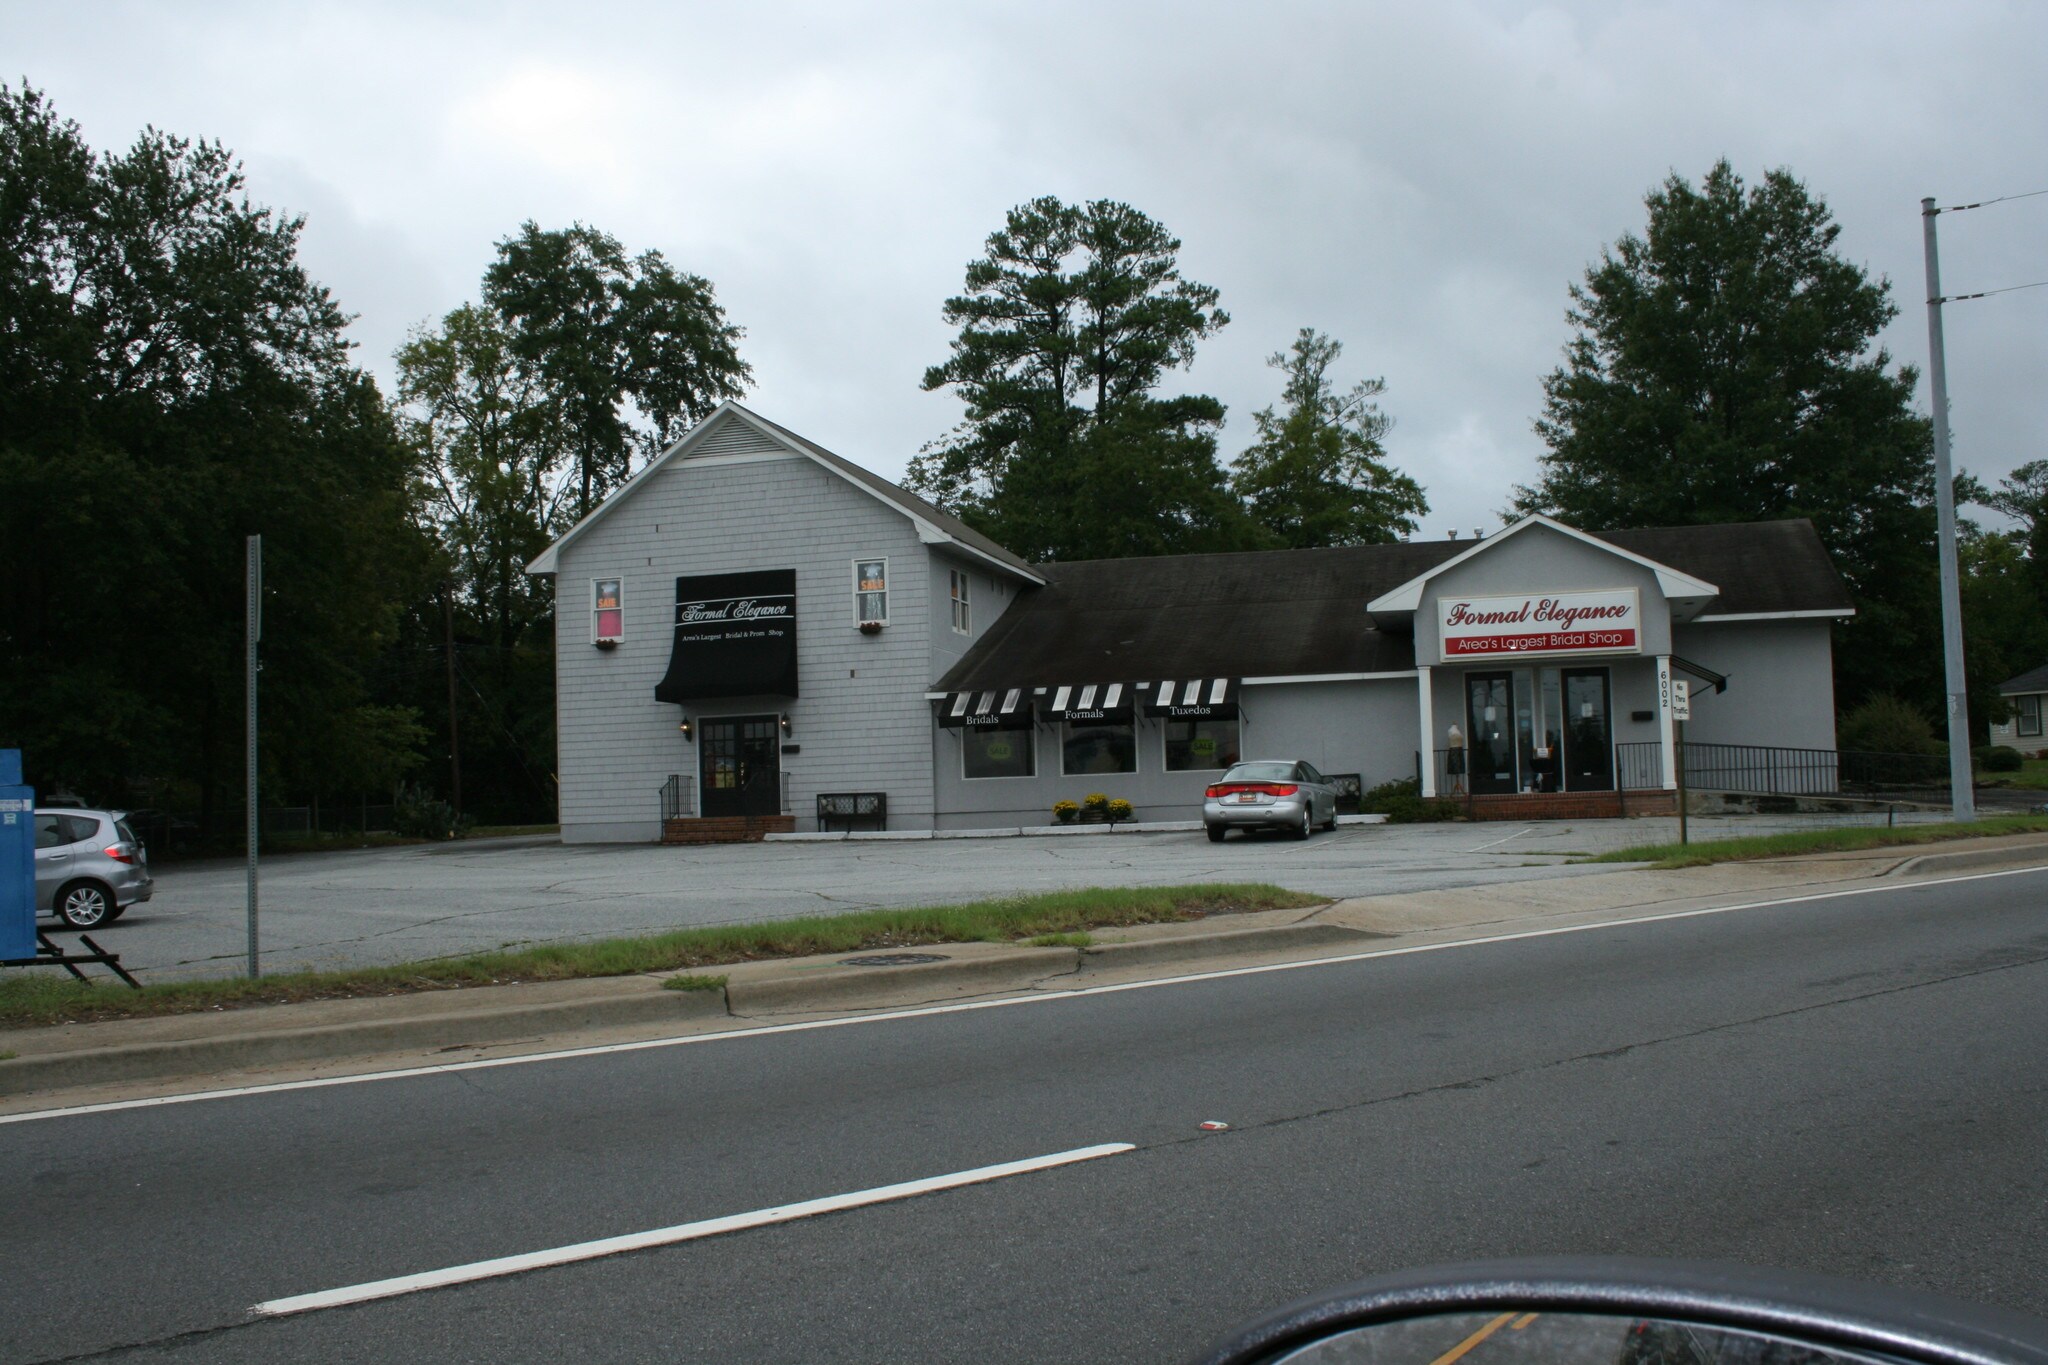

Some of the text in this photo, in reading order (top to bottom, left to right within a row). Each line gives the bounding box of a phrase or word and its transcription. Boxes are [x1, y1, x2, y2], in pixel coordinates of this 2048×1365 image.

[861, 579, 884, 590] SALE
[682, 600, 787, 621] Formal Elegance
[1446, 599, 1631, 630] Formal Elegance
[701, 633, 721, 641] Largest
[725, 631, 743, 639] Bridal
[768, 629, 784, 637] Shop
[1458, 632, 1623, 651] Area's Largest Bridal Shop
[1660, 671, 1668, 707] 6002
[1675, 695, 1686, 703] Thru
[1064, 708, 1104, 719] Formals
[1169, 705, 1211, 715] Tuxedos
[966, 714, 999, 725] Bridals
